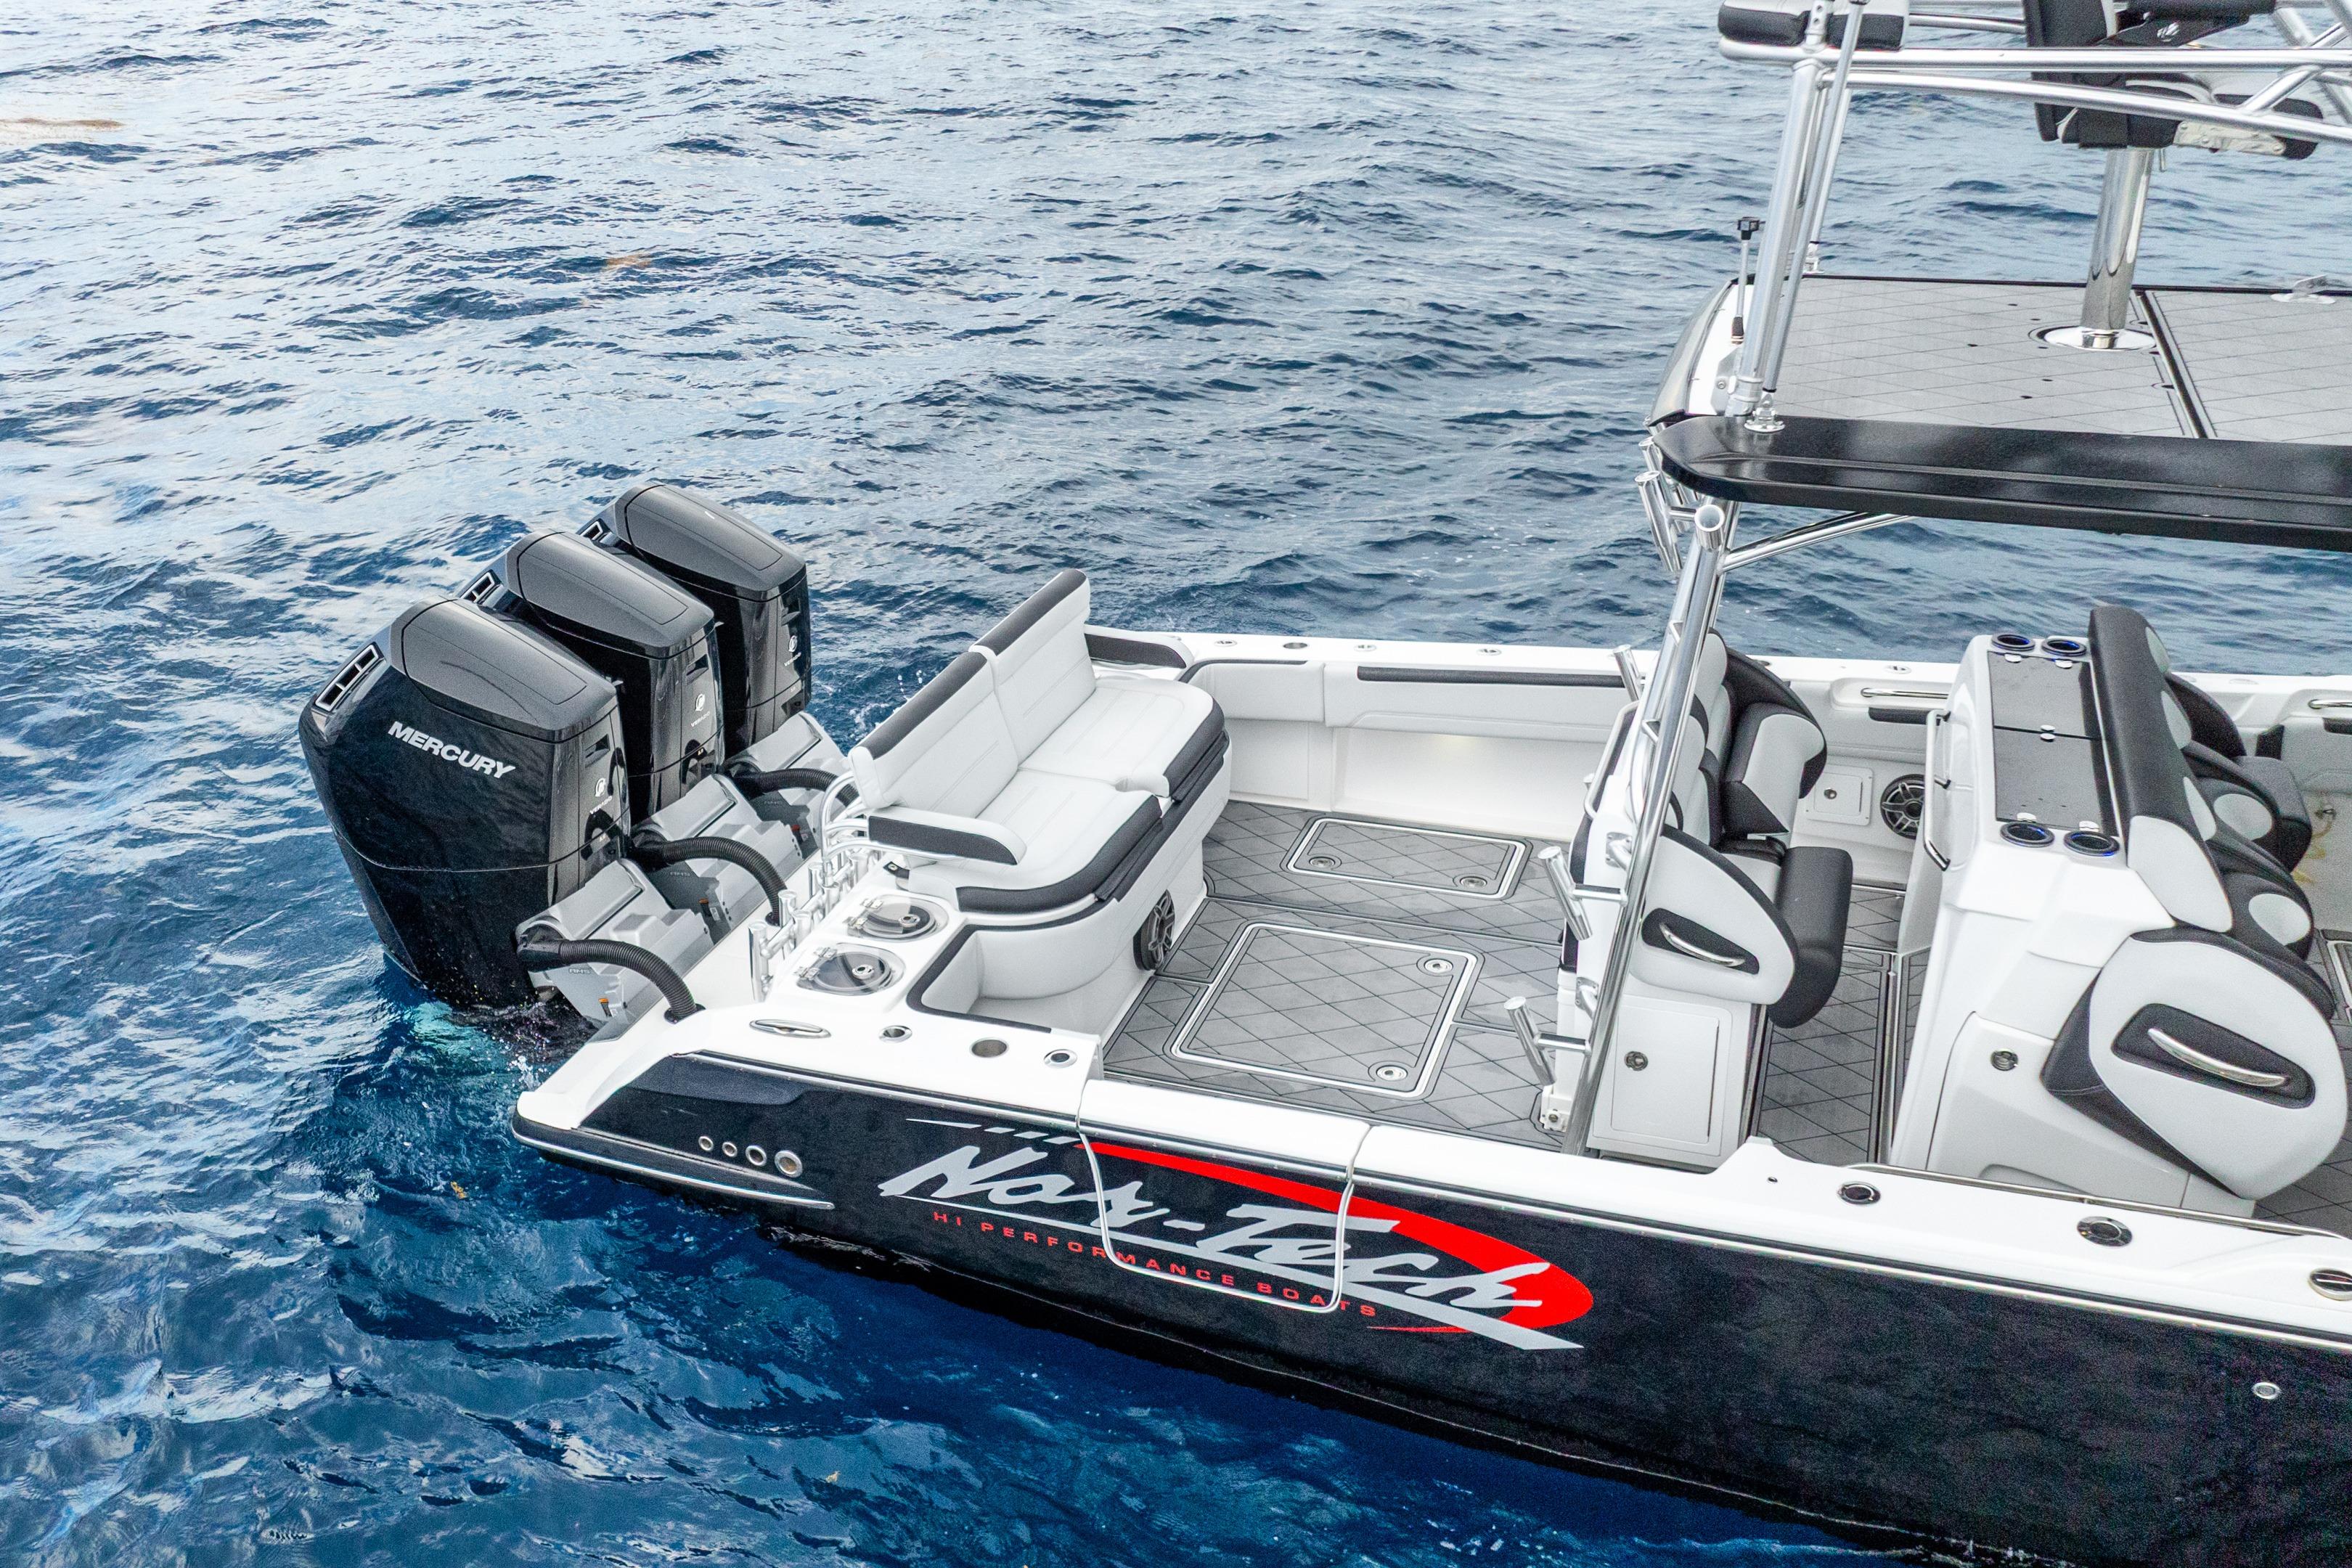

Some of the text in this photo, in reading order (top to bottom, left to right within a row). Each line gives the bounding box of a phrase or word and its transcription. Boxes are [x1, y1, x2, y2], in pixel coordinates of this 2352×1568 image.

[388, 721, 516, 779] MERCURY
[589, 795, 613, 814] VERADO
[934, 1212, 1376, 1317] HI PERFORMANCE BOATS
